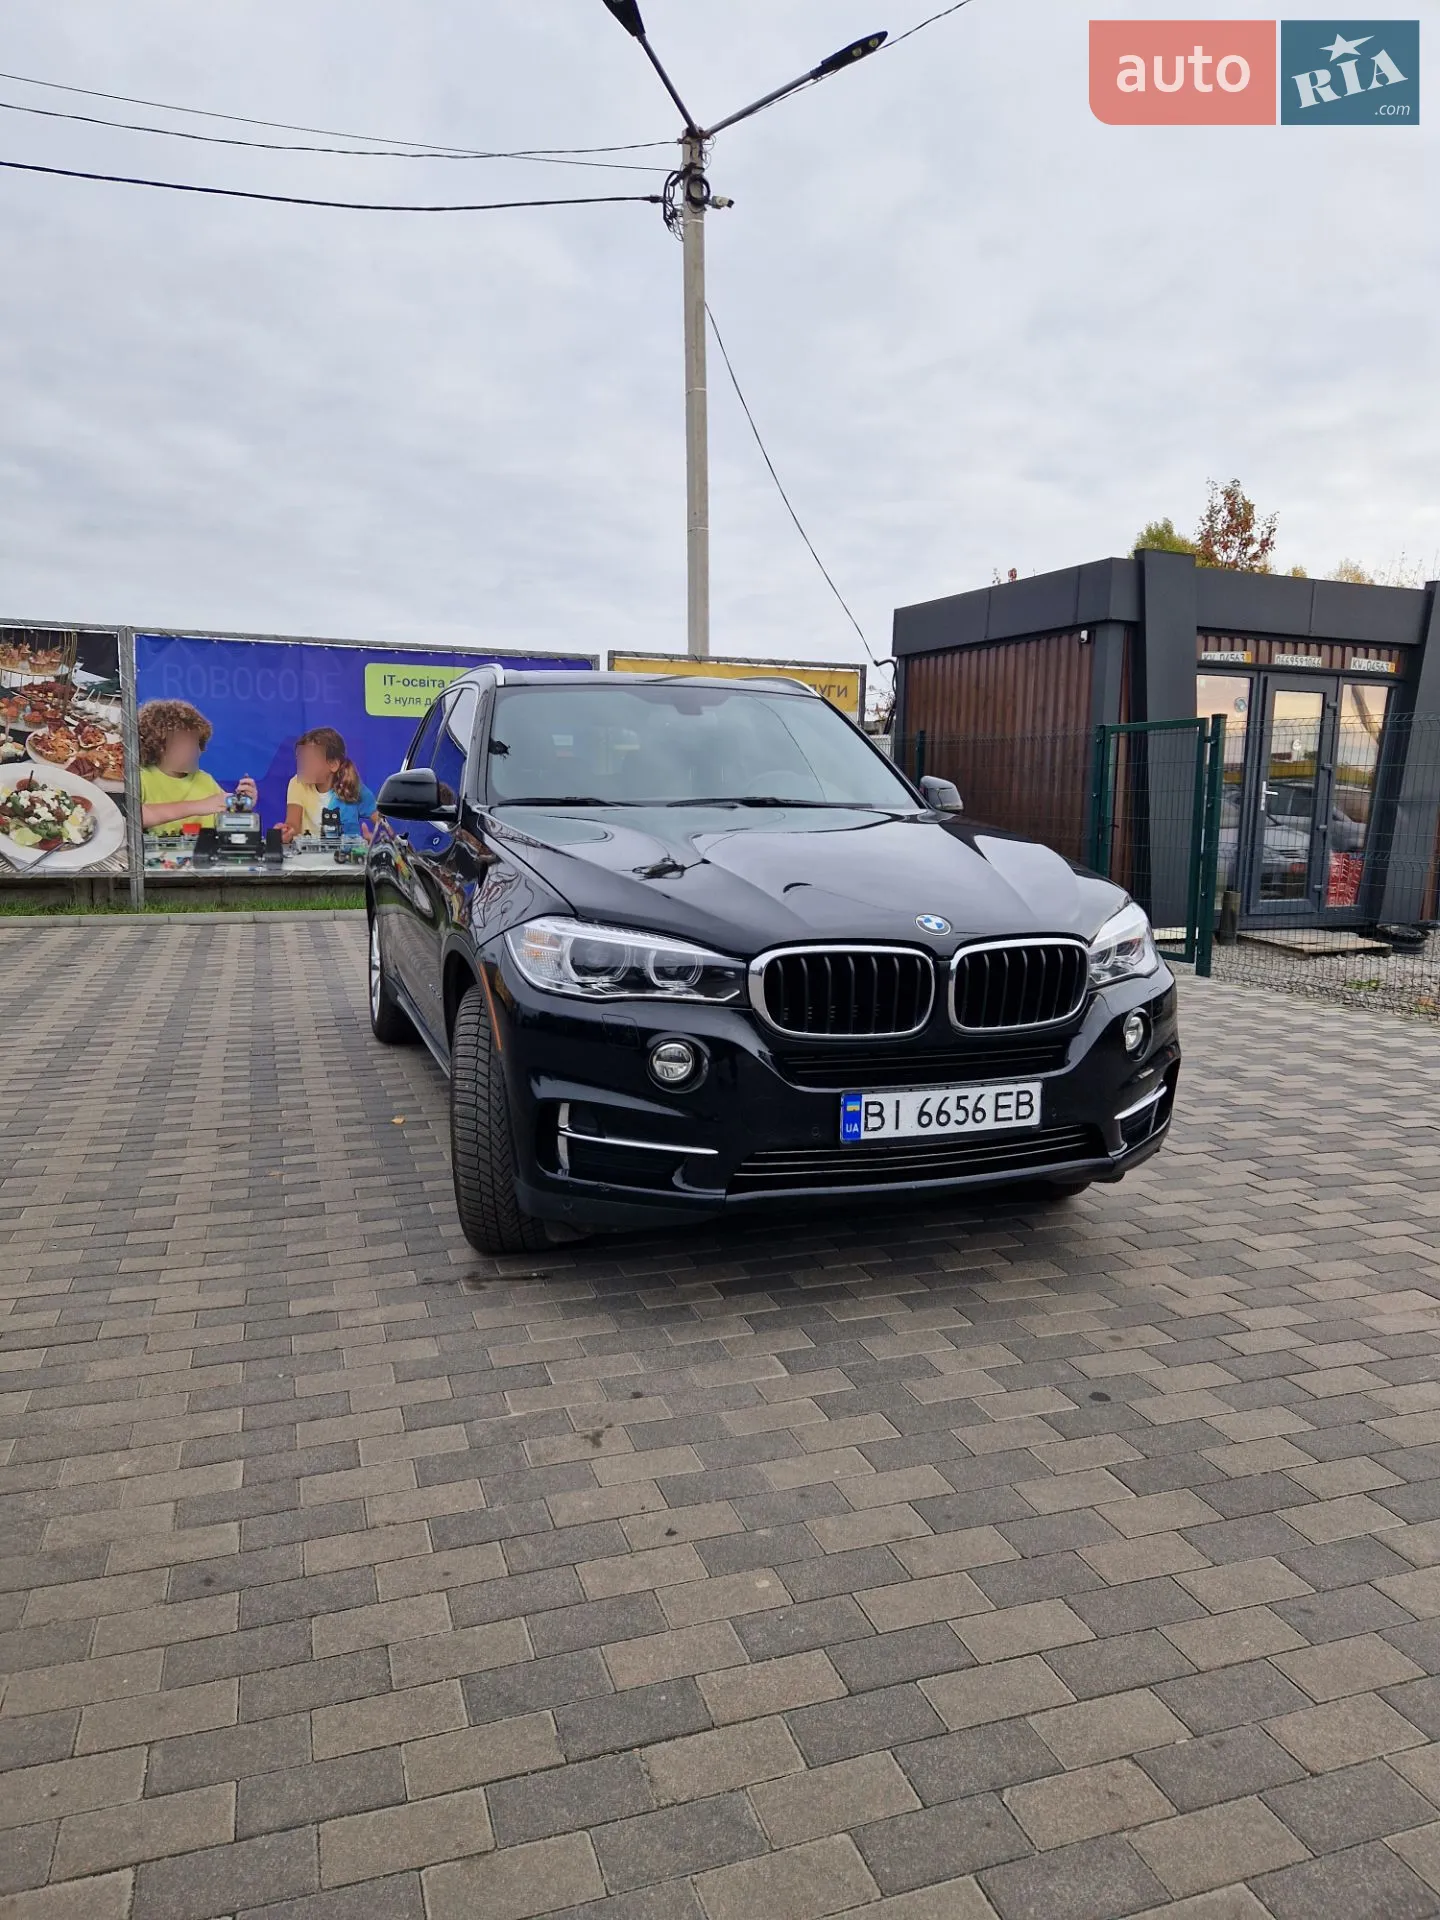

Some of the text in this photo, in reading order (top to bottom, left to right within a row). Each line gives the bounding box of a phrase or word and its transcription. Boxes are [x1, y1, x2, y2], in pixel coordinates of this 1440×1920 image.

[161, 662, 343, 705] ROBOCODE
[394, 696, 422, 708] нуля
[864, 1089, 1035, 1132] BI 6656 EB
[845, 1123, 859, 1134] UA
